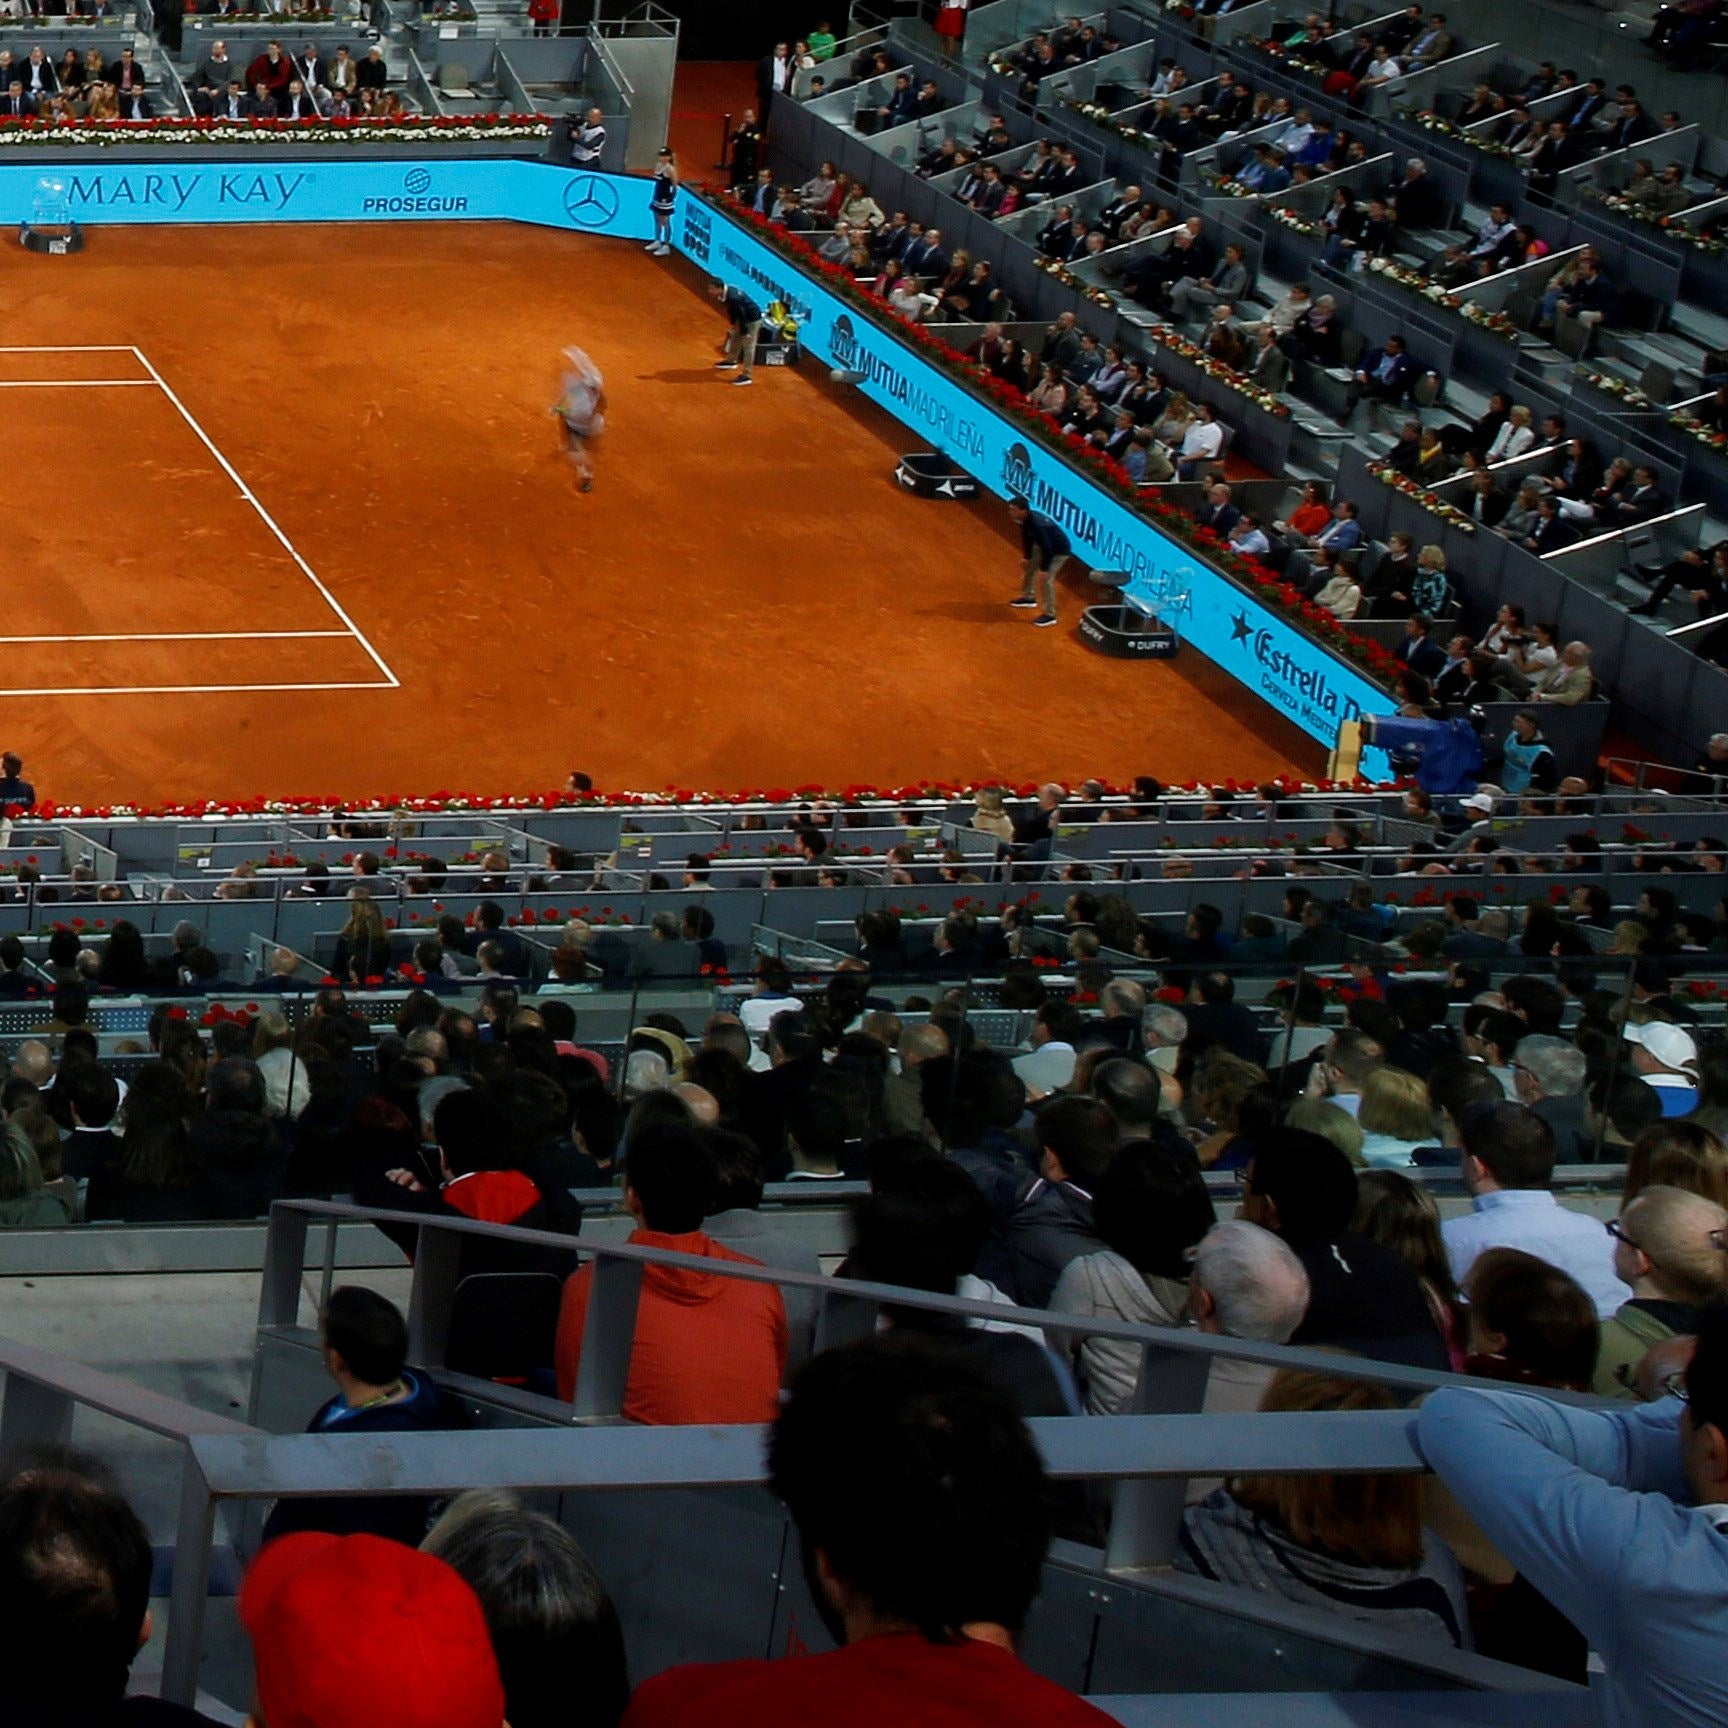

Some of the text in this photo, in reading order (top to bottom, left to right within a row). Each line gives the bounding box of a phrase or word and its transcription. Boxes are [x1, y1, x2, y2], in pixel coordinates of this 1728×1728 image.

[69, 173, 306, 212] MARY KAY
[362, 196, 468, 213] PROSEGUR
[1136, 640, 1171, 650] DUFRY
[1254, 627, 1338, 719] Estrella
